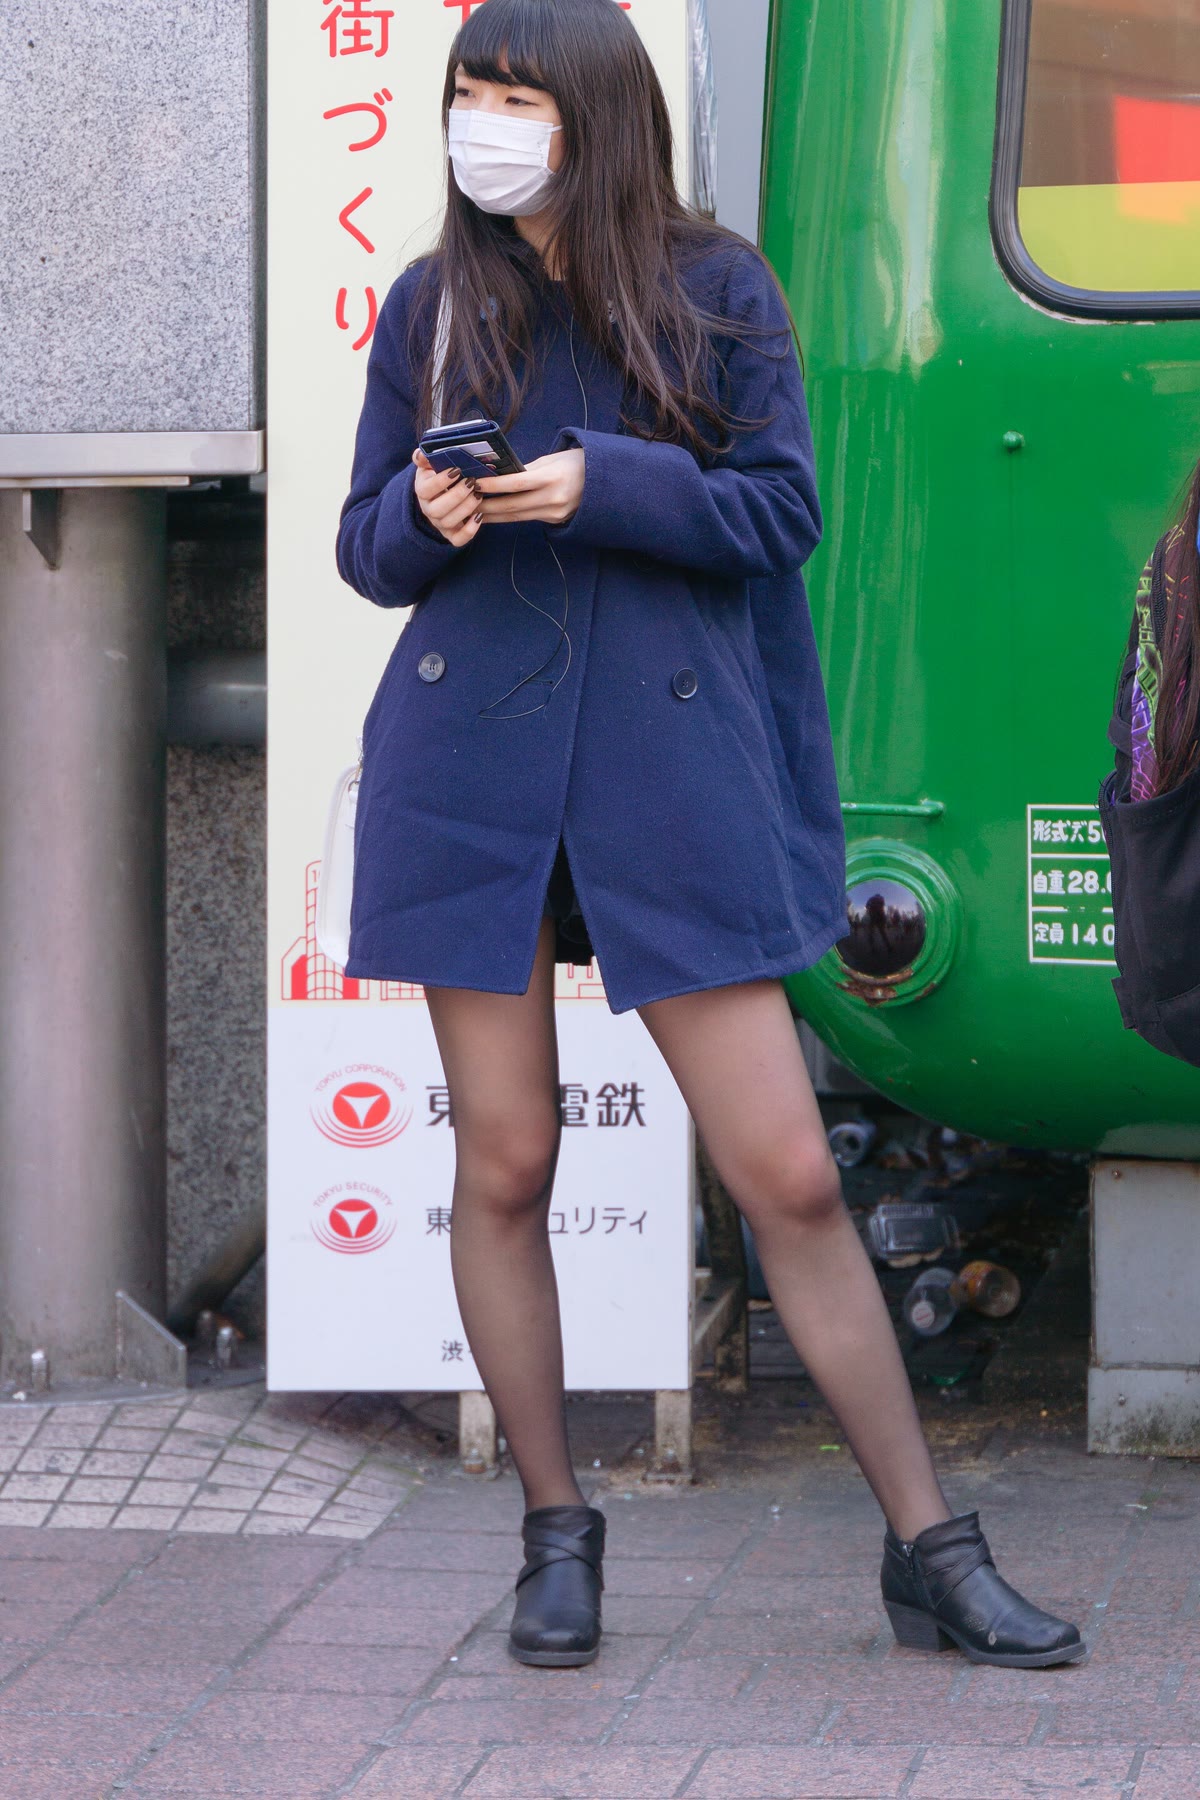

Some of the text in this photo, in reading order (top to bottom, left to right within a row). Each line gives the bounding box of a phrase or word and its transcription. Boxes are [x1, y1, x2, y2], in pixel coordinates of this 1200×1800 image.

[321, 0, 394, 351] 街づくり
[314, 1063, 408, 1092] TOKYU CORPORATION
[312, 1181, 393, 1208] TOKYU SECURITY
